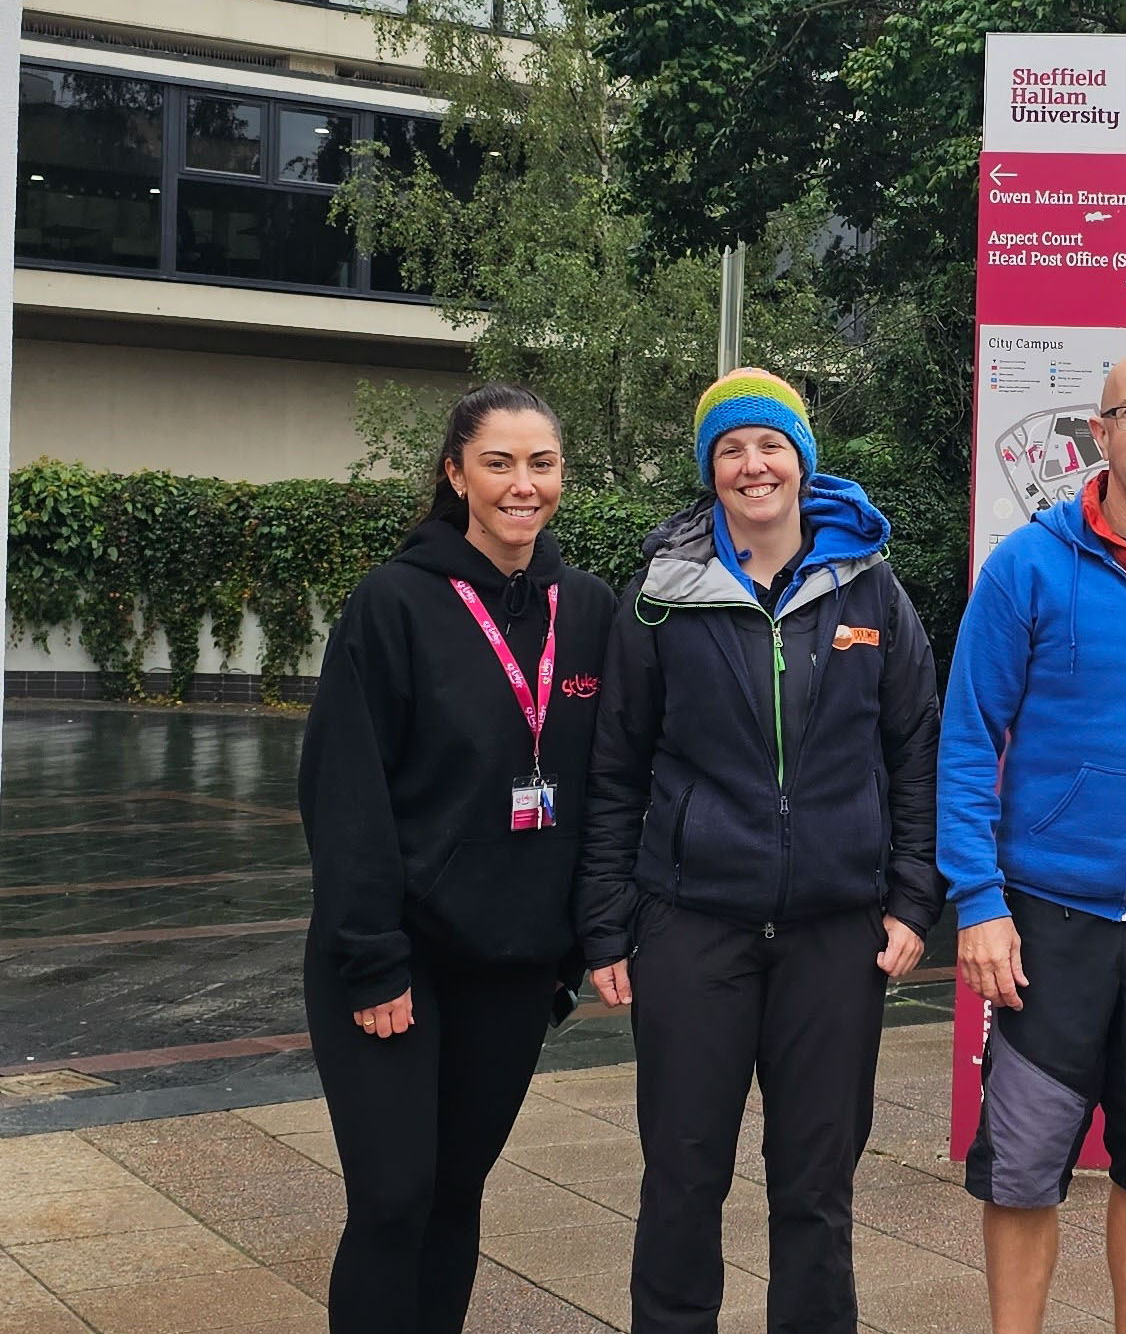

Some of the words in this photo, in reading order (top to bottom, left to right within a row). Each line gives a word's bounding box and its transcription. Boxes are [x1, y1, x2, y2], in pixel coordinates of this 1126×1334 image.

[1012, 68, 1107, 86] Sheffield
[1010, 87, 1088, 105] Hallam
[1010, 105, 1121, 130] University
[989, 189, 1031, 204] Owen
[1035, 190, 1074, 205] Main
[987, 230, 1039, 249] Aspect
[1041, 231, 1084, 247] Court
[987, 251, 1027, 266] Head
[1030, 252, 1063, 267] Post
[1065, 252, 1109, 268] Office
[988, 337, 1012, 352] City
[1015, 338, 1064, 352] Campus
